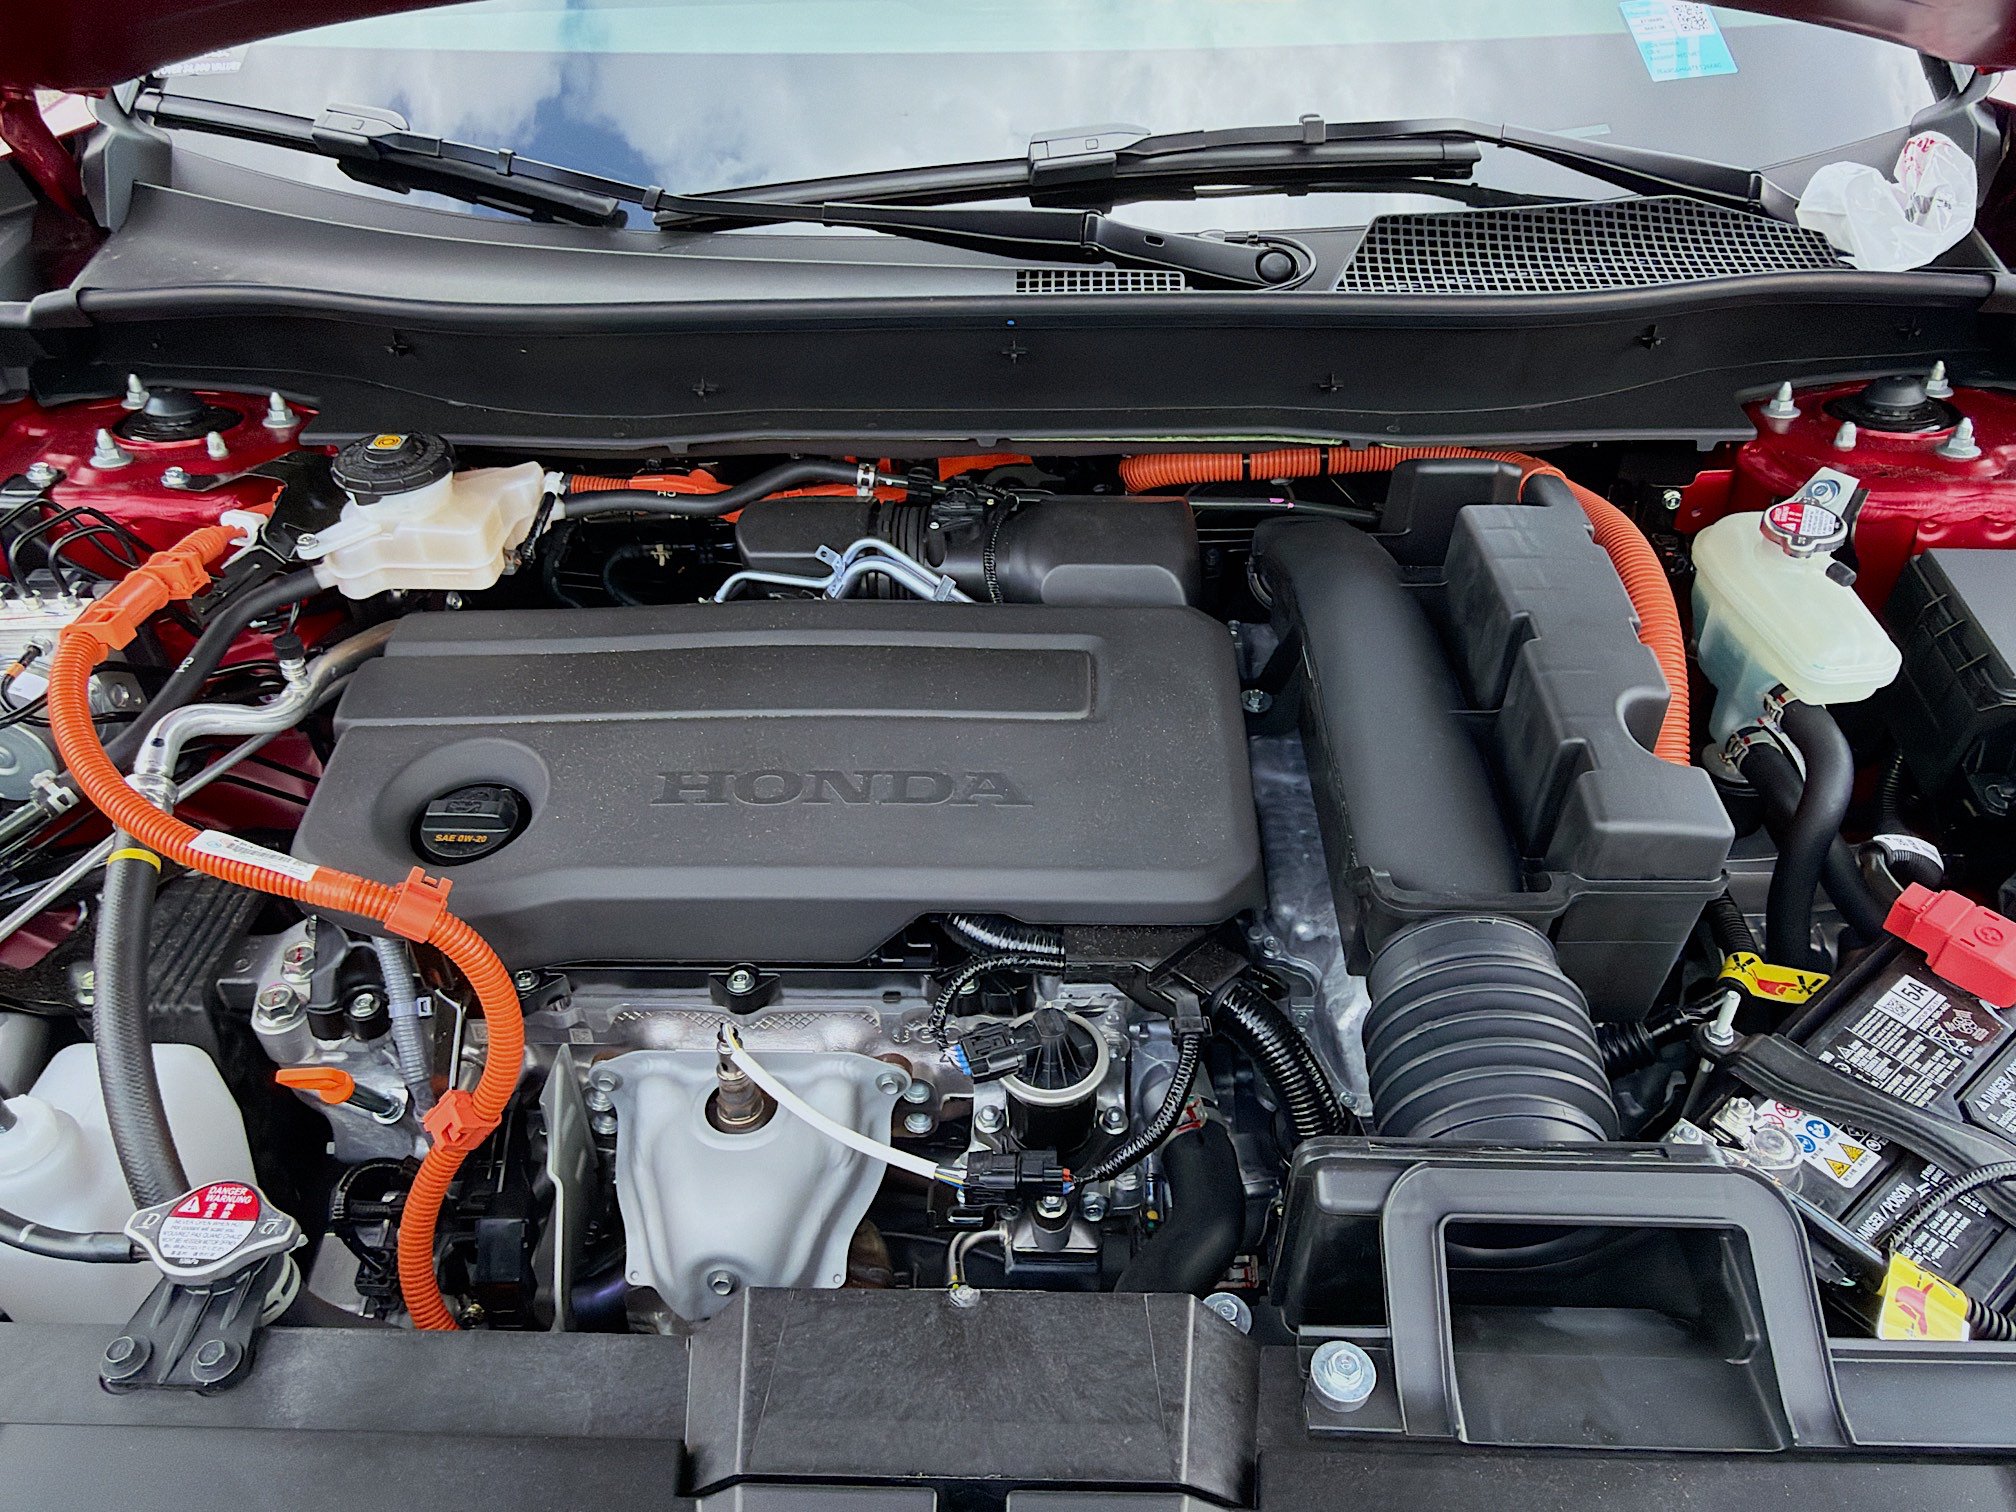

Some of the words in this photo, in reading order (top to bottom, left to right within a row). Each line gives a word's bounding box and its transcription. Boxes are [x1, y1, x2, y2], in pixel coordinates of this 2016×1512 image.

[650, 769, 1034, 808] HONDA
[435, 834, 455, 842] SAE
[457, 834, 488, 843] 0W-20
[1901, 982, 1928, 1001] 5A
[208, 1186, 247, 1195] DANGER
